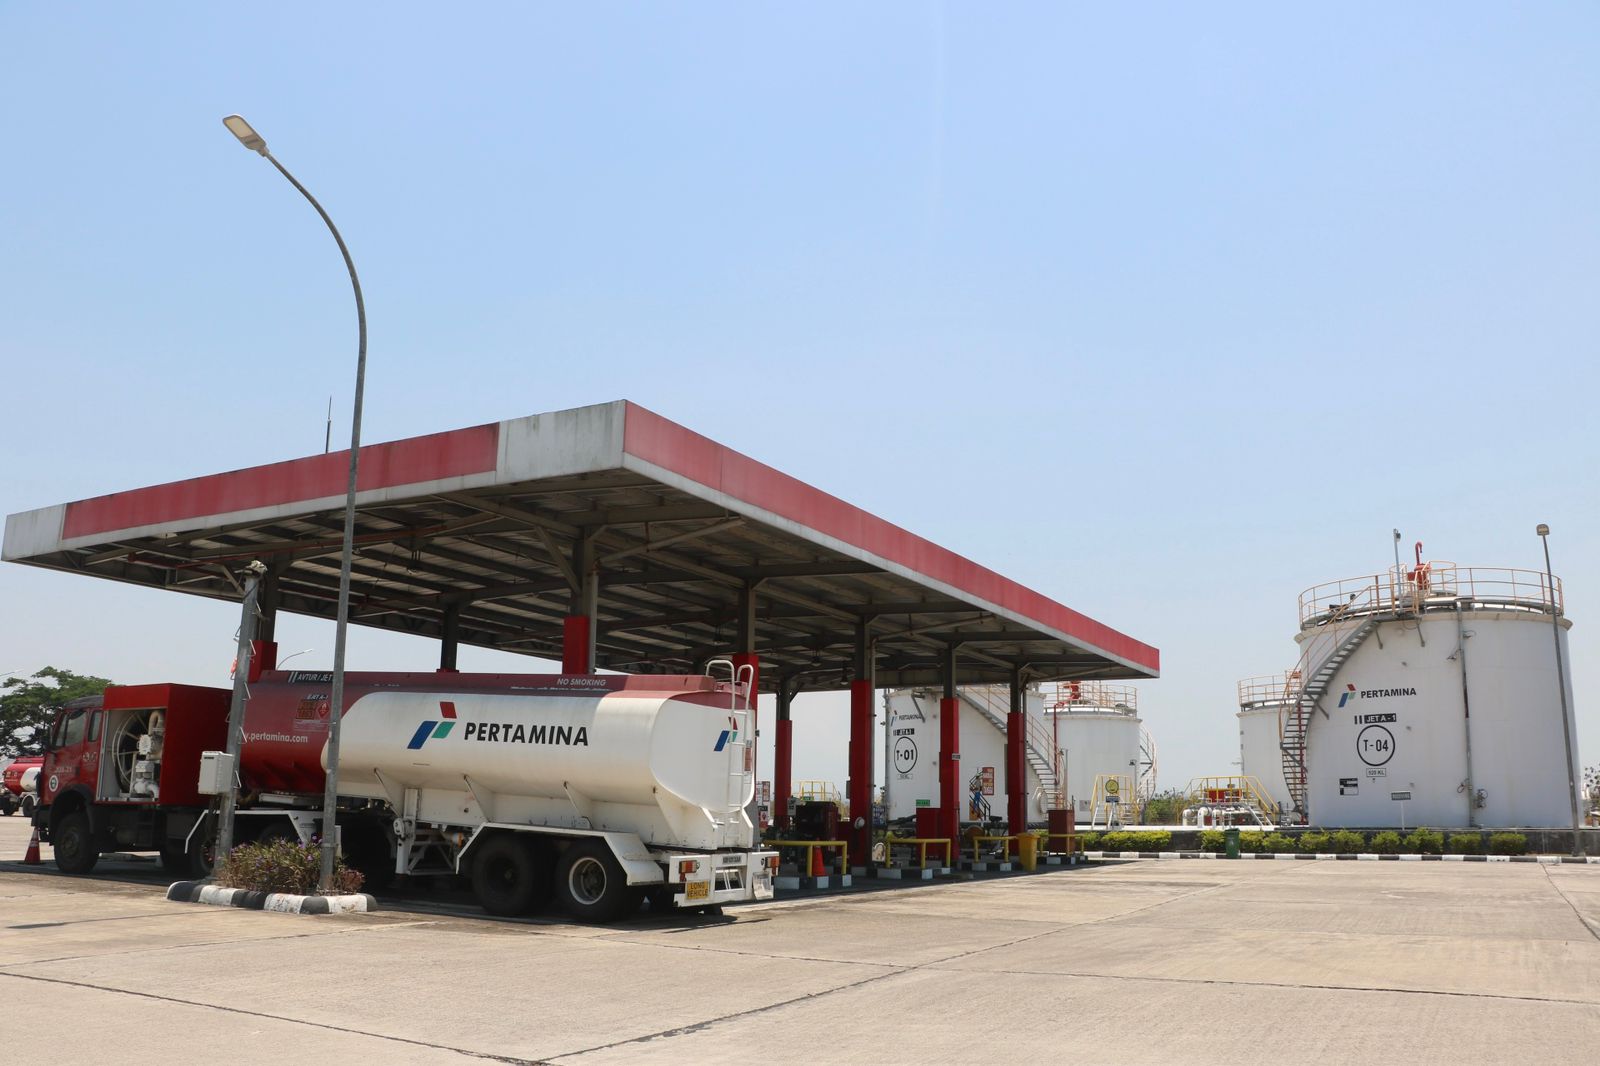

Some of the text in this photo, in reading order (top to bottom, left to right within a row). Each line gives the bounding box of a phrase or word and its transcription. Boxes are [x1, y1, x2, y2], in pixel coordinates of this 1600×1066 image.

[297, 673, 317, 681] AVTUR
[556, 678, 607, 687] NO SMOKING
[1360, 687, 1417, 699] PERTAMINA
[1366, 715, 1380, 723] JET
[463, 722, 589, 746] PERTAMINA
[1363, 739, 1389, 752] T-04
[896, 749, 914, 761] T-01
[687, 889, 708, 897] VEHICLE
